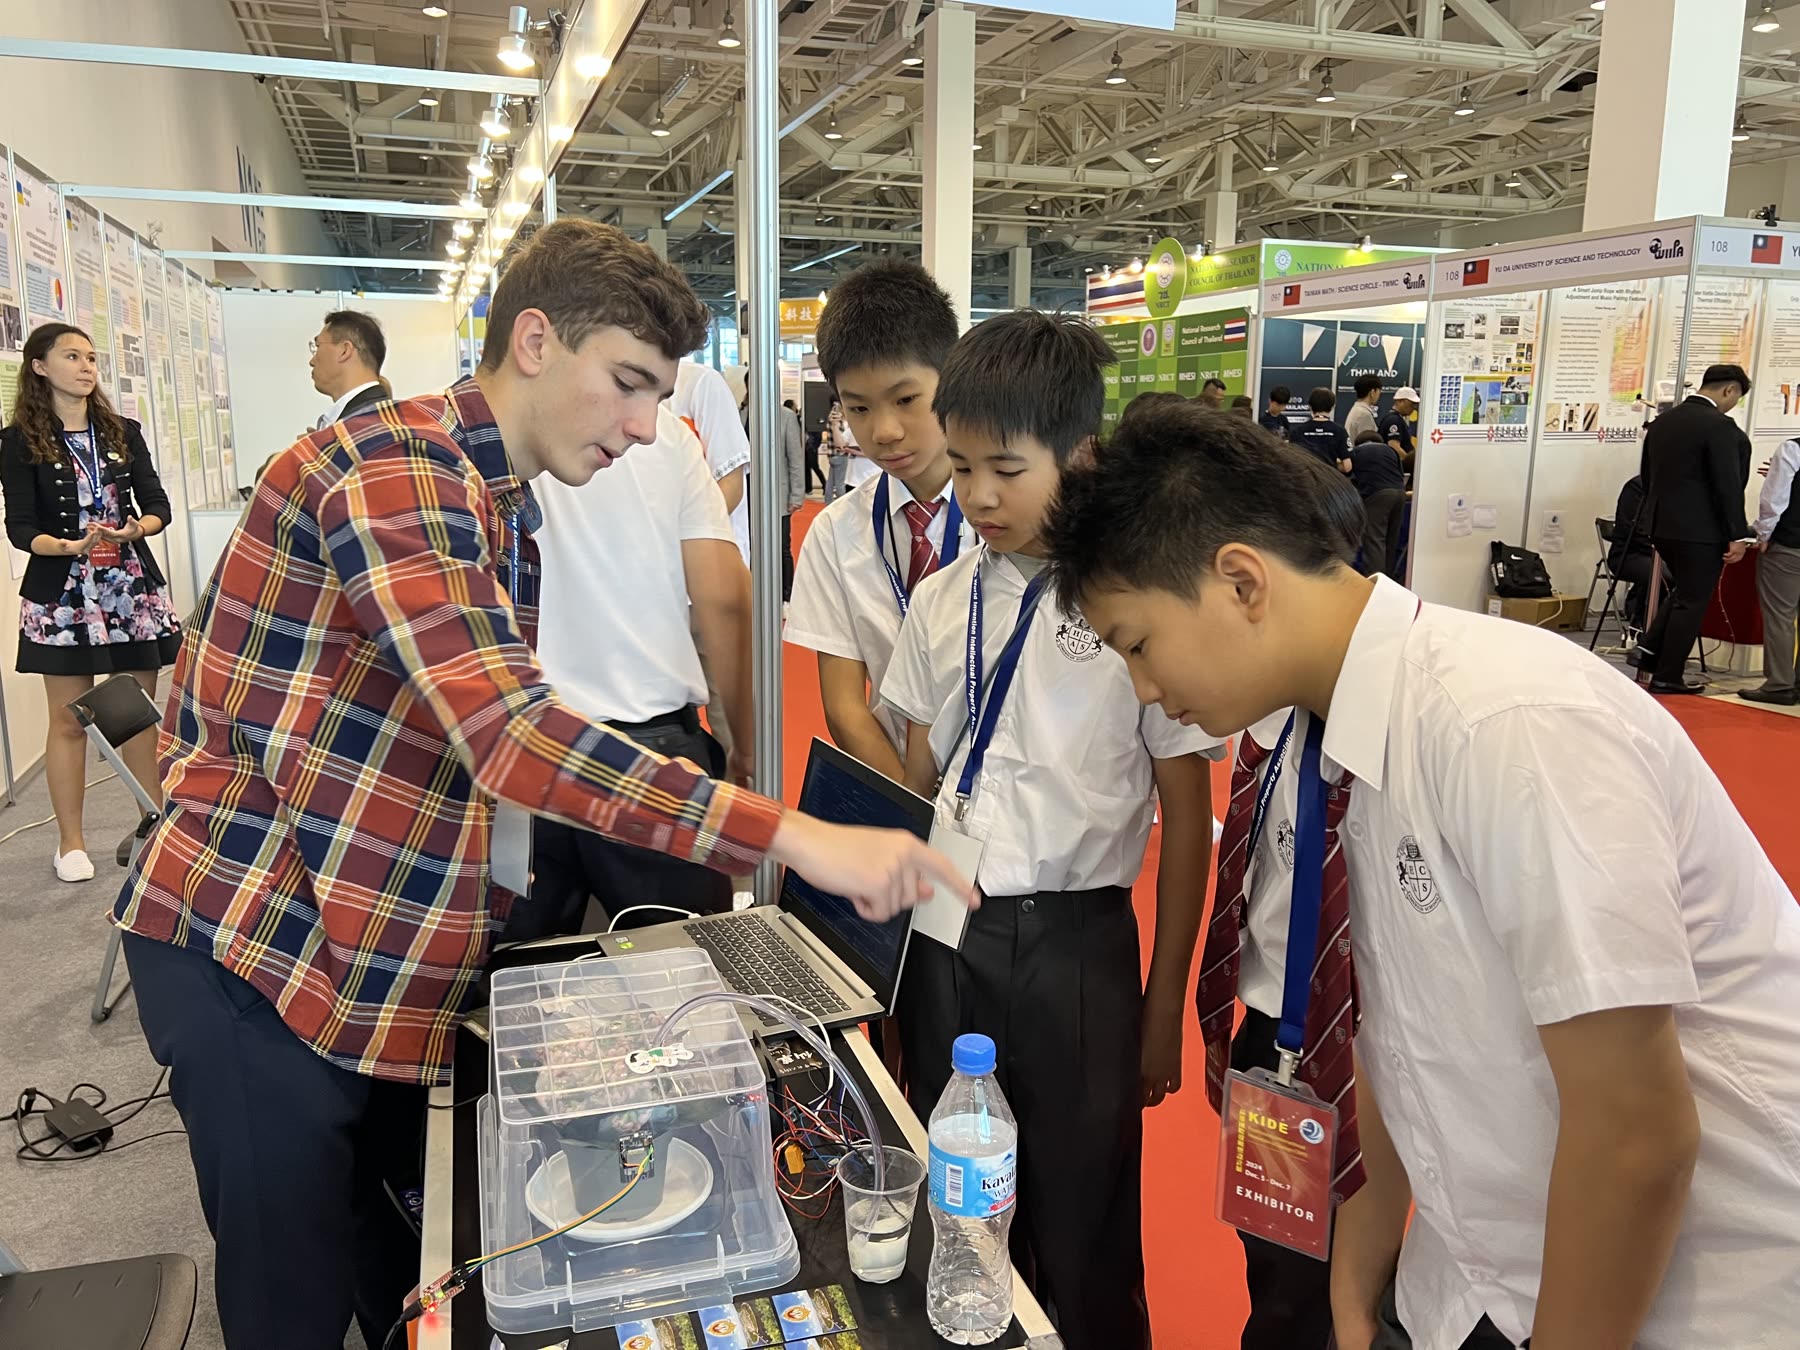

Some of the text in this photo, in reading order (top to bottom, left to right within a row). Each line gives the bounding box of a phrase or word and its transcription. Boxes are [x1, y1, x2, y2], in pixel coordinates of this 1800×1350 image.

[1711, 240, 1728, 253] 108
[1792, 245, 1800, 257] Y
[1296, 262, 1344, 272] NATION
[1445, 270, 1459, 281] 108
[1511, 260, 1544, 271] UNIVERSITY
[1545, 259, 1553, 267] OF
[1554, 255, 1581, 266] SCIENCE
[1582, 253, 1595, 261] AND
[1597, 248, 1641, 260] TECHNOLOGY
[1216, 274, 1223, 282] OF
[1225, 267, 1256, 280] THAILAND
[1304, 289, 1321, 297] TAIWAN
[1337, 284, 1359, 293] SCIENCE
[1360, 281, 1378, 290] CIRCLE
[1182, 323, 1221, 334] National Research
[1181, 334, 1223, 345] Council of Thailand
[1121, 375, 1136, 384] NRCT
[1158, 373, 1175, 382] NRCT
[1200, 371, 1219, 380] NRCT
[1083, 633, 1090, 641] C
[1080, 643, 1086, 651] S
[969, 636, 977, 680] Intellectual
[968, 680, 977, 714] Property
[1261, 773, 1276, 807] Property
[1419, 865, 1426, 876] C
[1421, 882, 1428, 892] S
[1248, 1111, 1289, 1135] KIDE
[1245, 1160, 1263, 1171] 2024
[1244, 1169, 1260, 1180] Dec.
[1269, 1178, 1285, 1190] Dec.
[1236, 1185, 1314, 1222] EXHIBITOR
